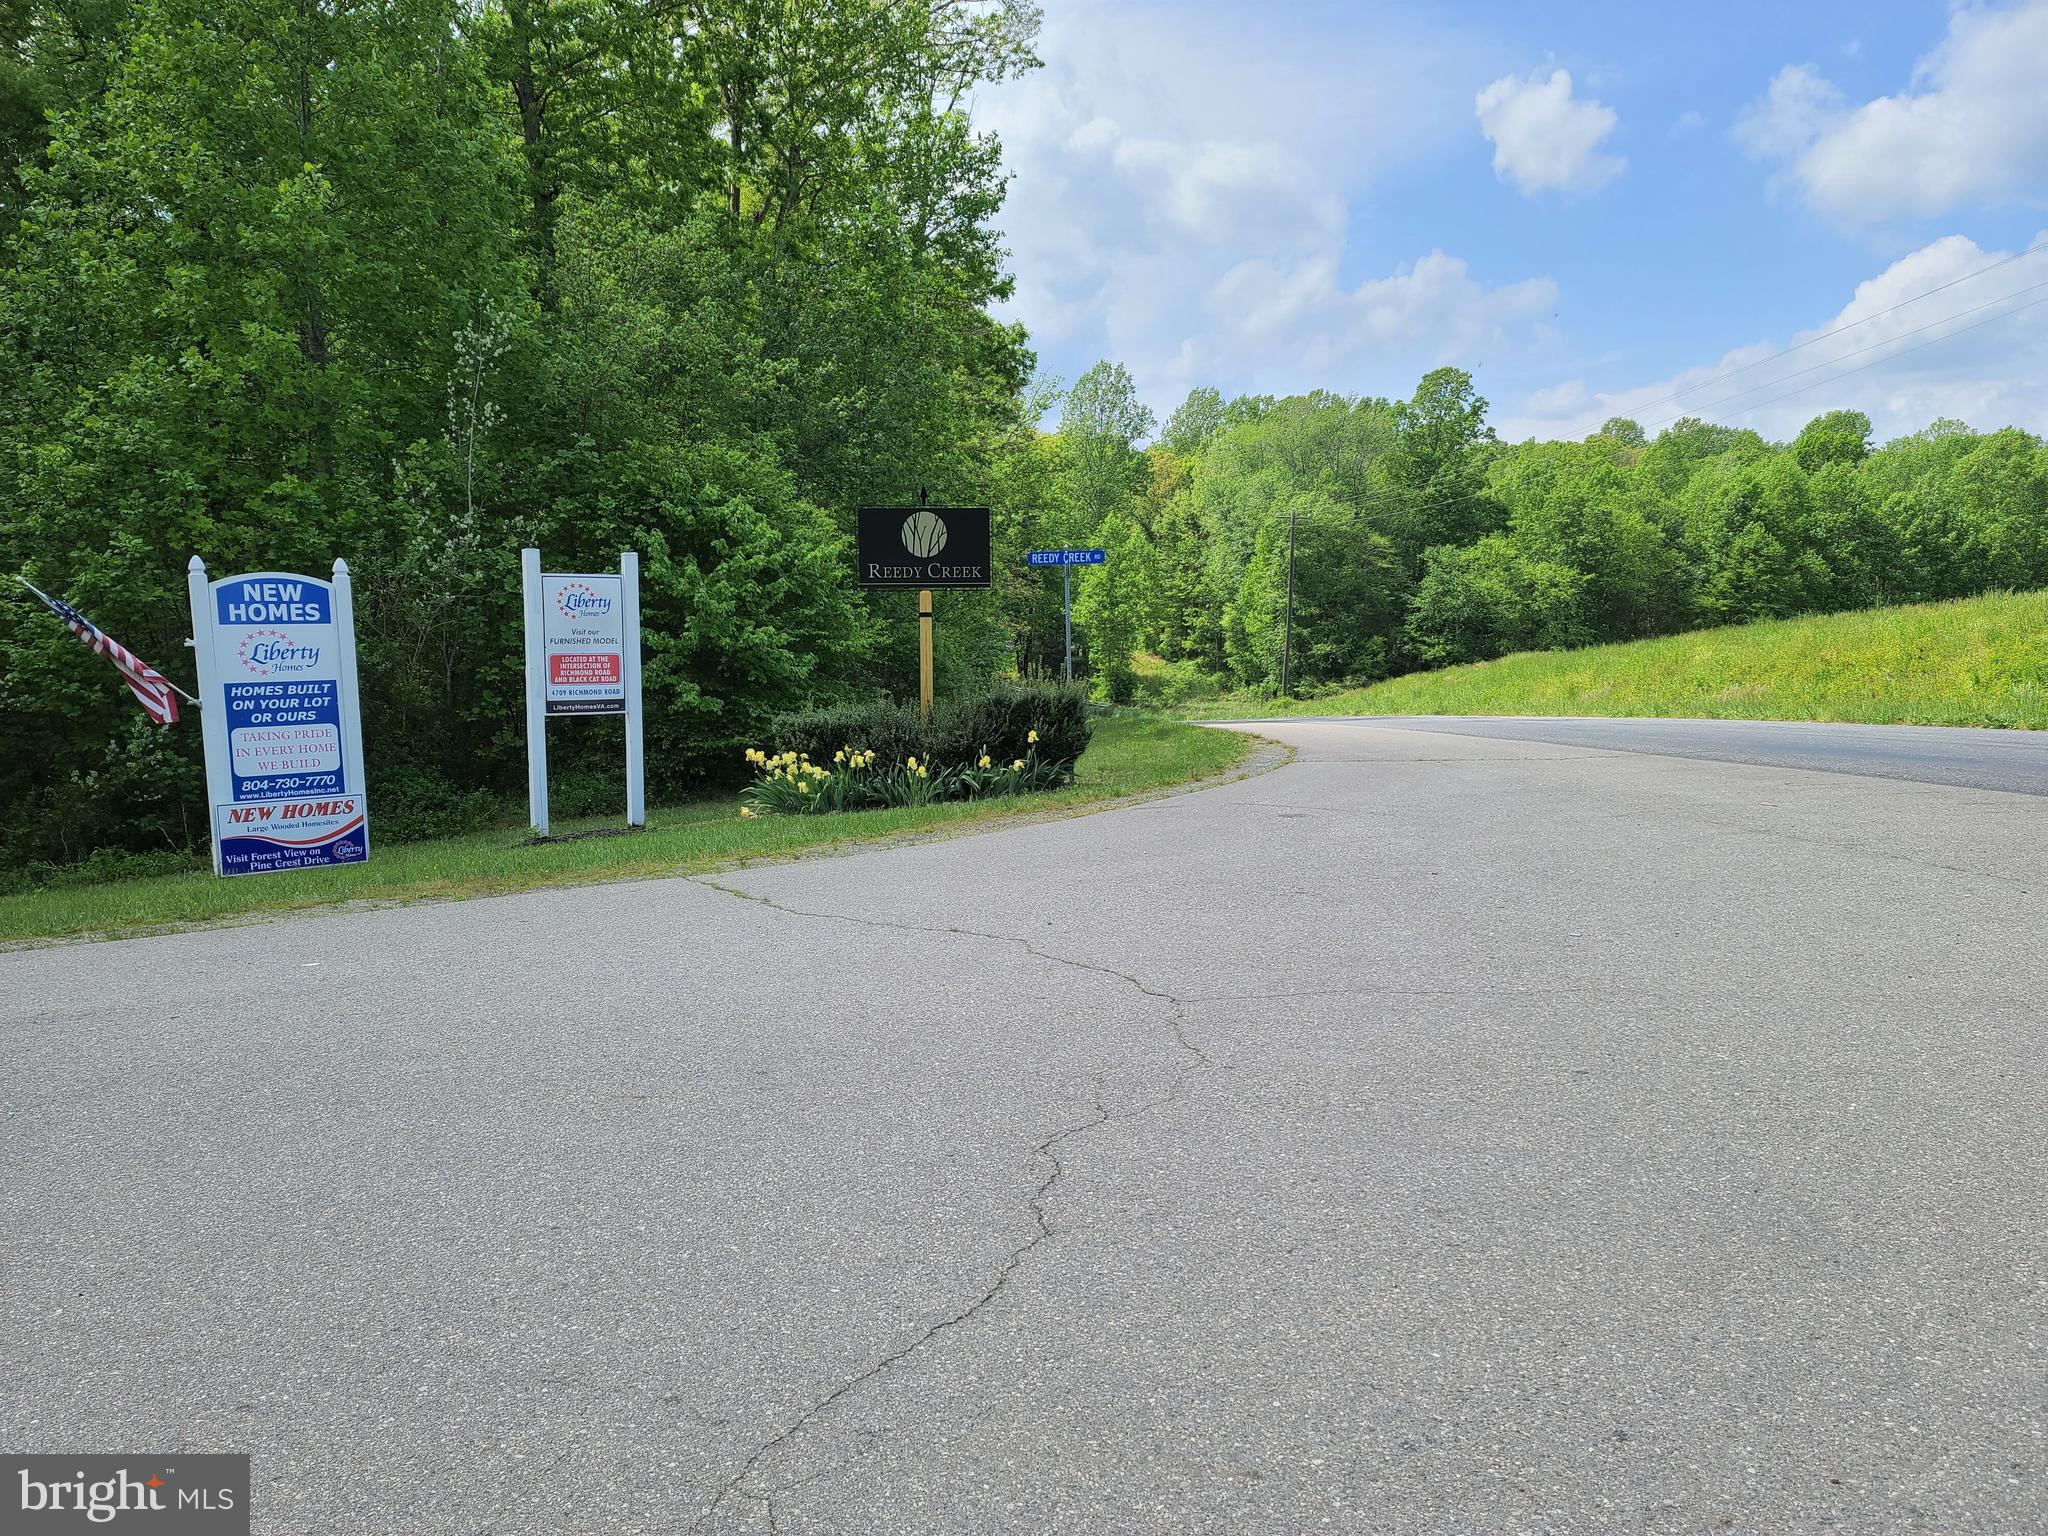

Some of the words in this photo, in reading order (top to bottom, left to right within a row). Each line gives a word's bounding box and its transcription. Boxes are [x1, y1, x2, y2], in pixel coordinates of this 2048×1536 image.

[1032, 553, 1059, 563] REEDY
[1063, 552, 1091, 563] CREEK
[868, 563, 923, 578] REEDY
[928, 563, 982, 578] CREEK
[243, 584, 302, 602] NEW
[564, 592, 611, 615] Liberty
[228, 603, 320, 622] HOMES
[578, 609, 600, 618] Homes
[549, 637, 591, 645] FURNISHED
[593, 637, 619, 645] MODEL
[249, 641, 320, 668] Liberty
[271, 661, 304, 674] Homes
[230, 685, 284, 697] HOMES
[287, 683, 331, 695] BUILT
[568, 688, 603, 696] RICHMOND
[232, 700, 255, 711] ON
[259, 698, 300, 710] YOUR
[303, 697, 331, 708] LOT
[552, 703, 620, 711] LibertyHomesVA.com
[251, 713, 273, 723] OR
[276, 710, 317, 722] OURS
[240, 730, 291, 742] TAKING
[294, 728, 333, 739] PRIDE
[235, 748, 250, 758] IN
[255, 745, 295, 757] EVERY
[299, 743, 337, 754] HOME
[258, 761, 278, 771] WE
[282, 758, 321, 770] BUILD
[241, 775, 336, 792] 804-730-7770
[239, 786, 340, 801] www.LibertyHomesInc.net
[227, 805, 277, 824] NEW
[280, 799, 354, 820] HOMES
[247, 825, 269, 834] Large
[271, 822, 300, 831] Wooded
[302, 819, 339, 829] Homesites
[226, 854, 249, 864] Visit
[251, 852, 281, 862] Forest
[284, 848, 307, 858] View
[309, 848, 321, 856] on
[250, 860, 272, 871] Pine
[274, 857, 301, 868] Crest
[304, 855, 330, 866] Drive
